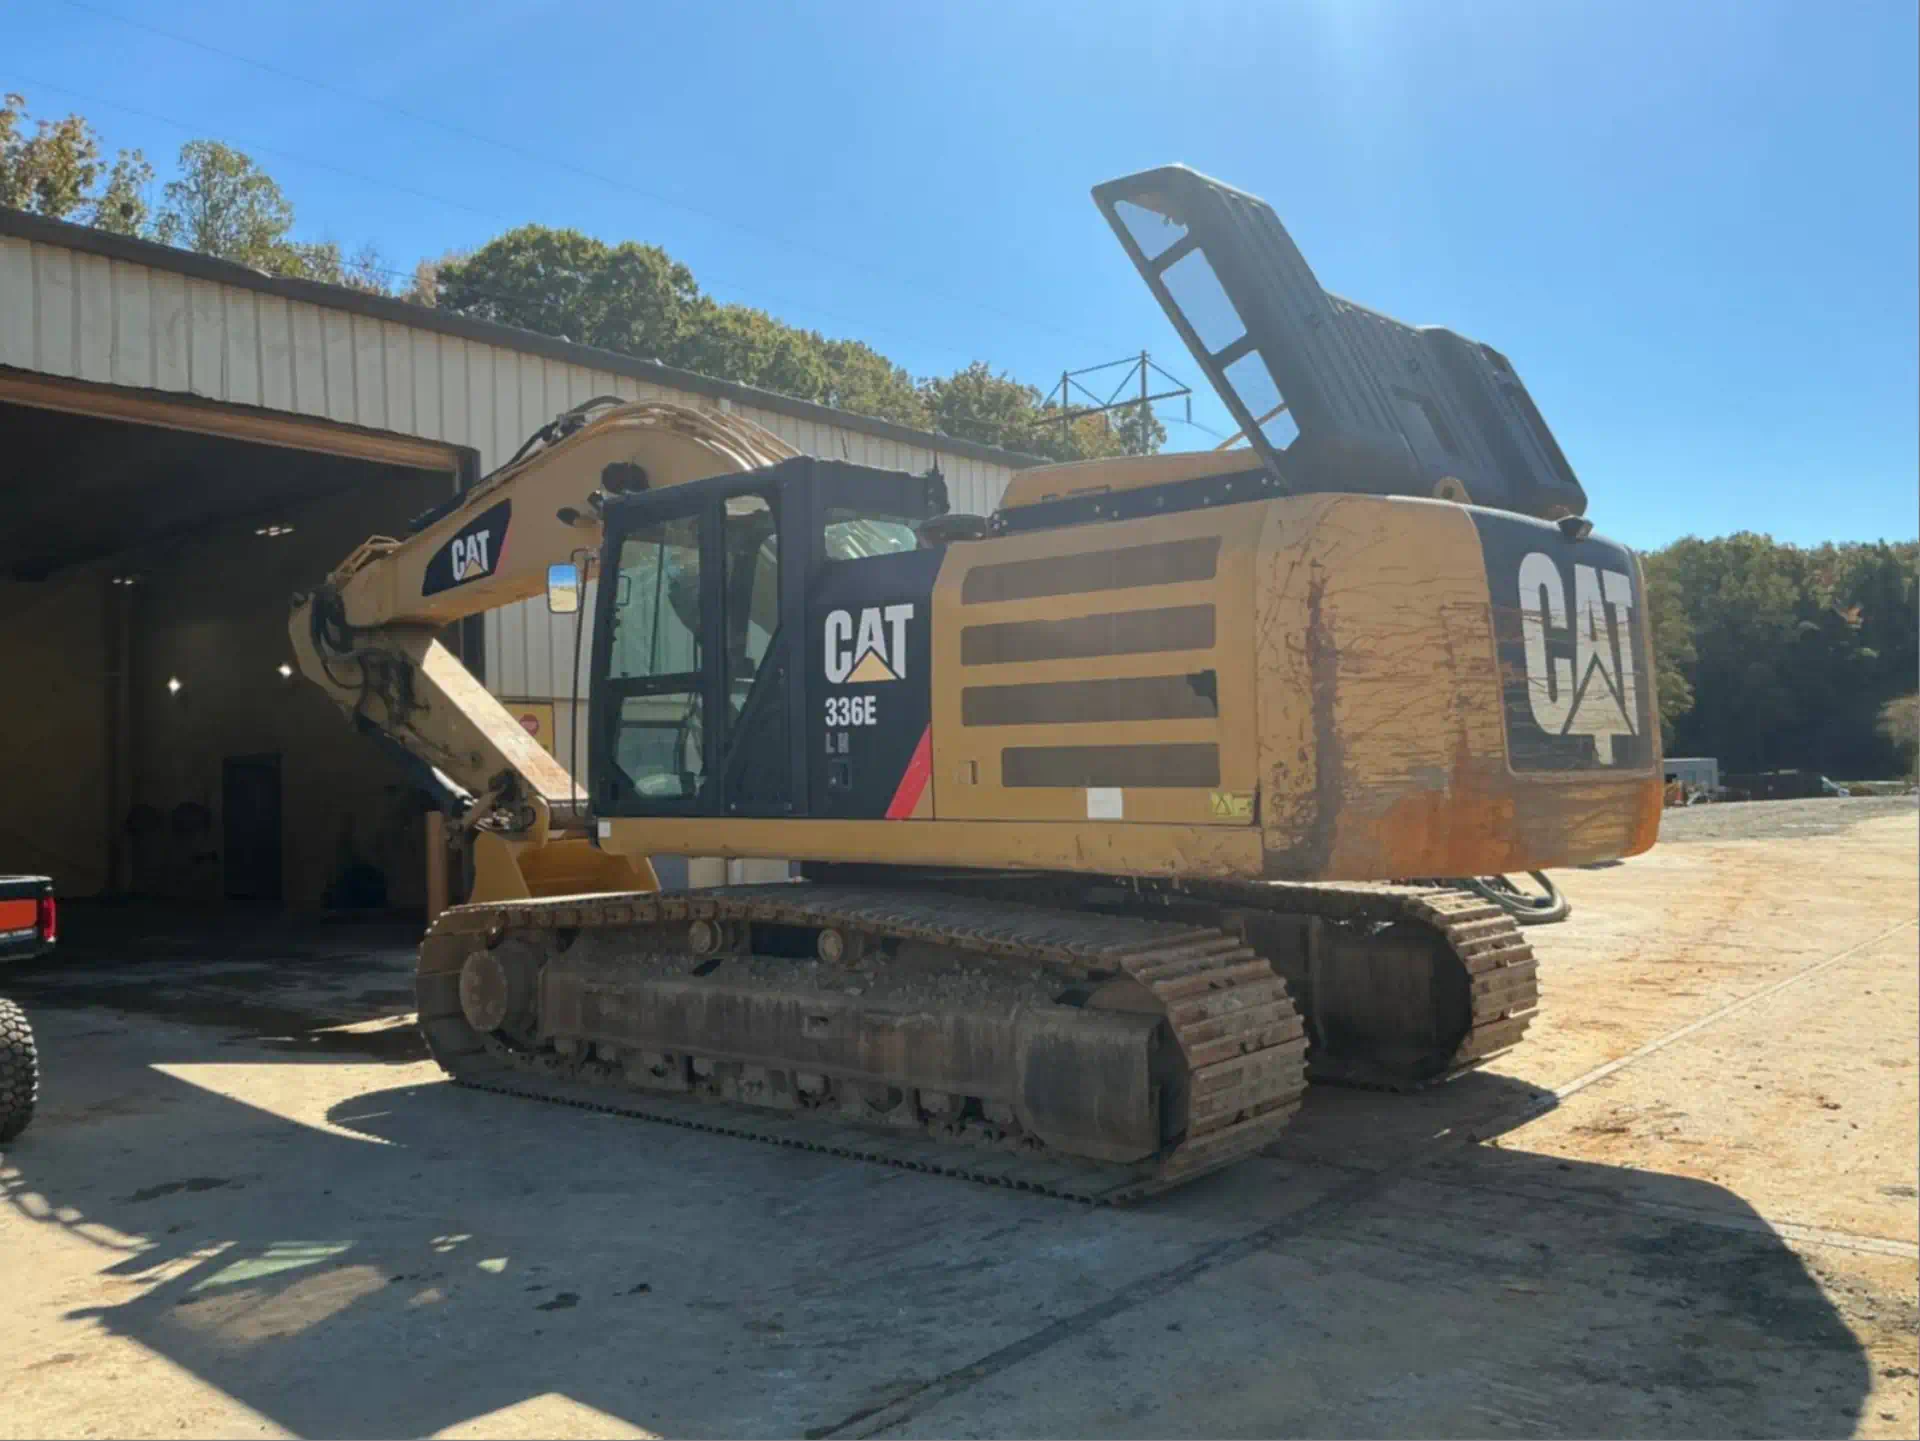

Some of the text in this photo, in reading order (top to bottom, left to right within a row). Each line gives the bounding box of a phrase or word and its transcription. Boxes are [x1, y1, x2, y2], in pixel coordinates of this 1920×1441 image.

[452, 530, 489, 581] CAT
[825, 604, 914, 684] CAT
[1518, 552, 1639, 736] CAT
[825, 696, 877, 727] 336E
